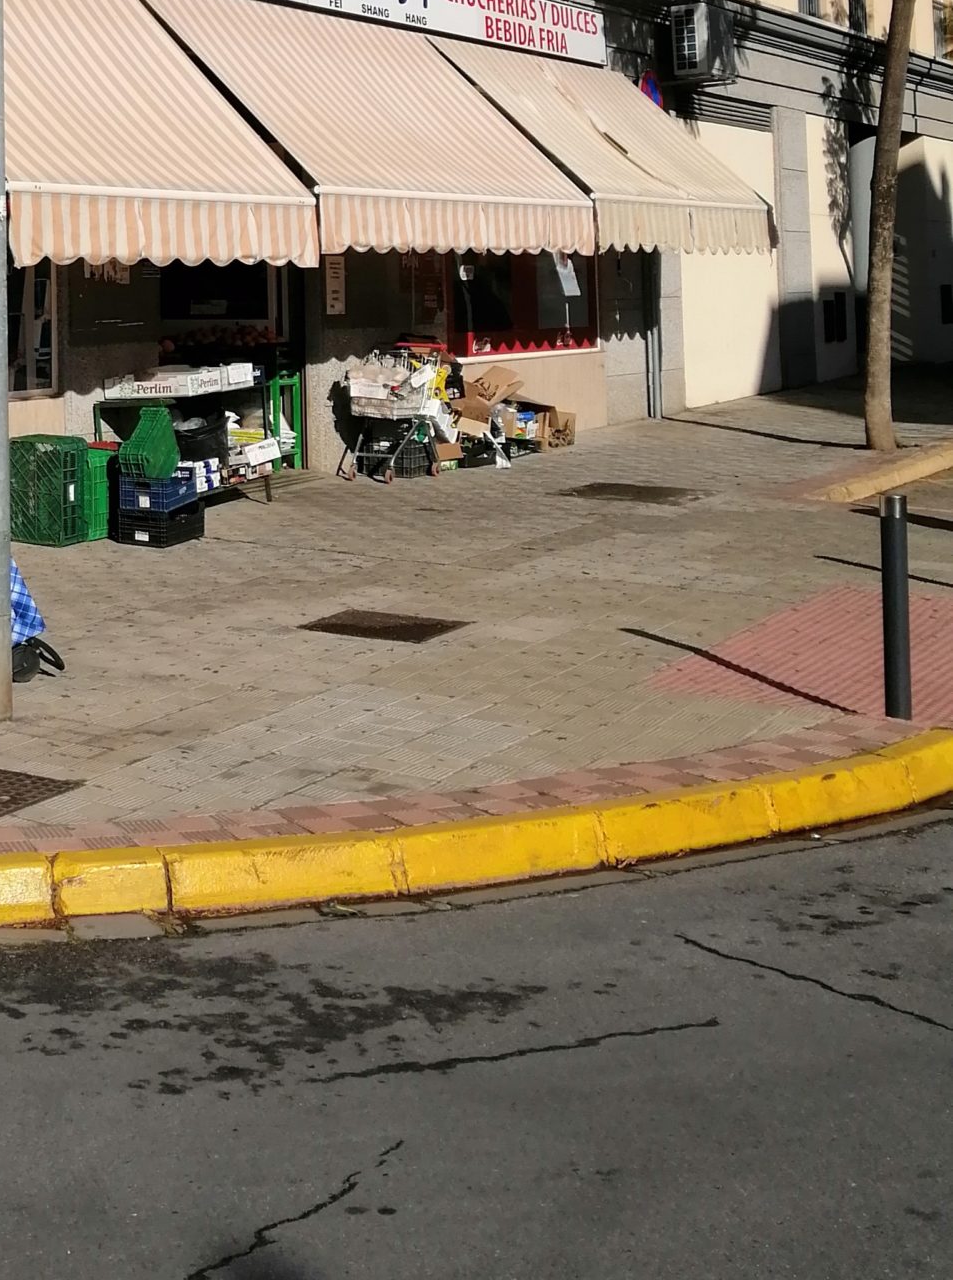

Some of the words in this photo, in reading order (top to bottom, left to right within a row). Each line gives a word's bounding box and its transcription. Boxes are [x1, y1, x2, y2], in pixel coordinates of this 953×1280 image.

[361, 2, 390, 19] SHANG
[405, 12, 428, 26] HANG
[537, 0, 548, 22] Y
[551, 4, 598, 36] DULCES
[485, 15, 536, 49] BEBIDA
[538, 28, 569, 54] FRIA
[137, 384, 172, 394] Perlim
[199, 377, 219, 388] Perlim
